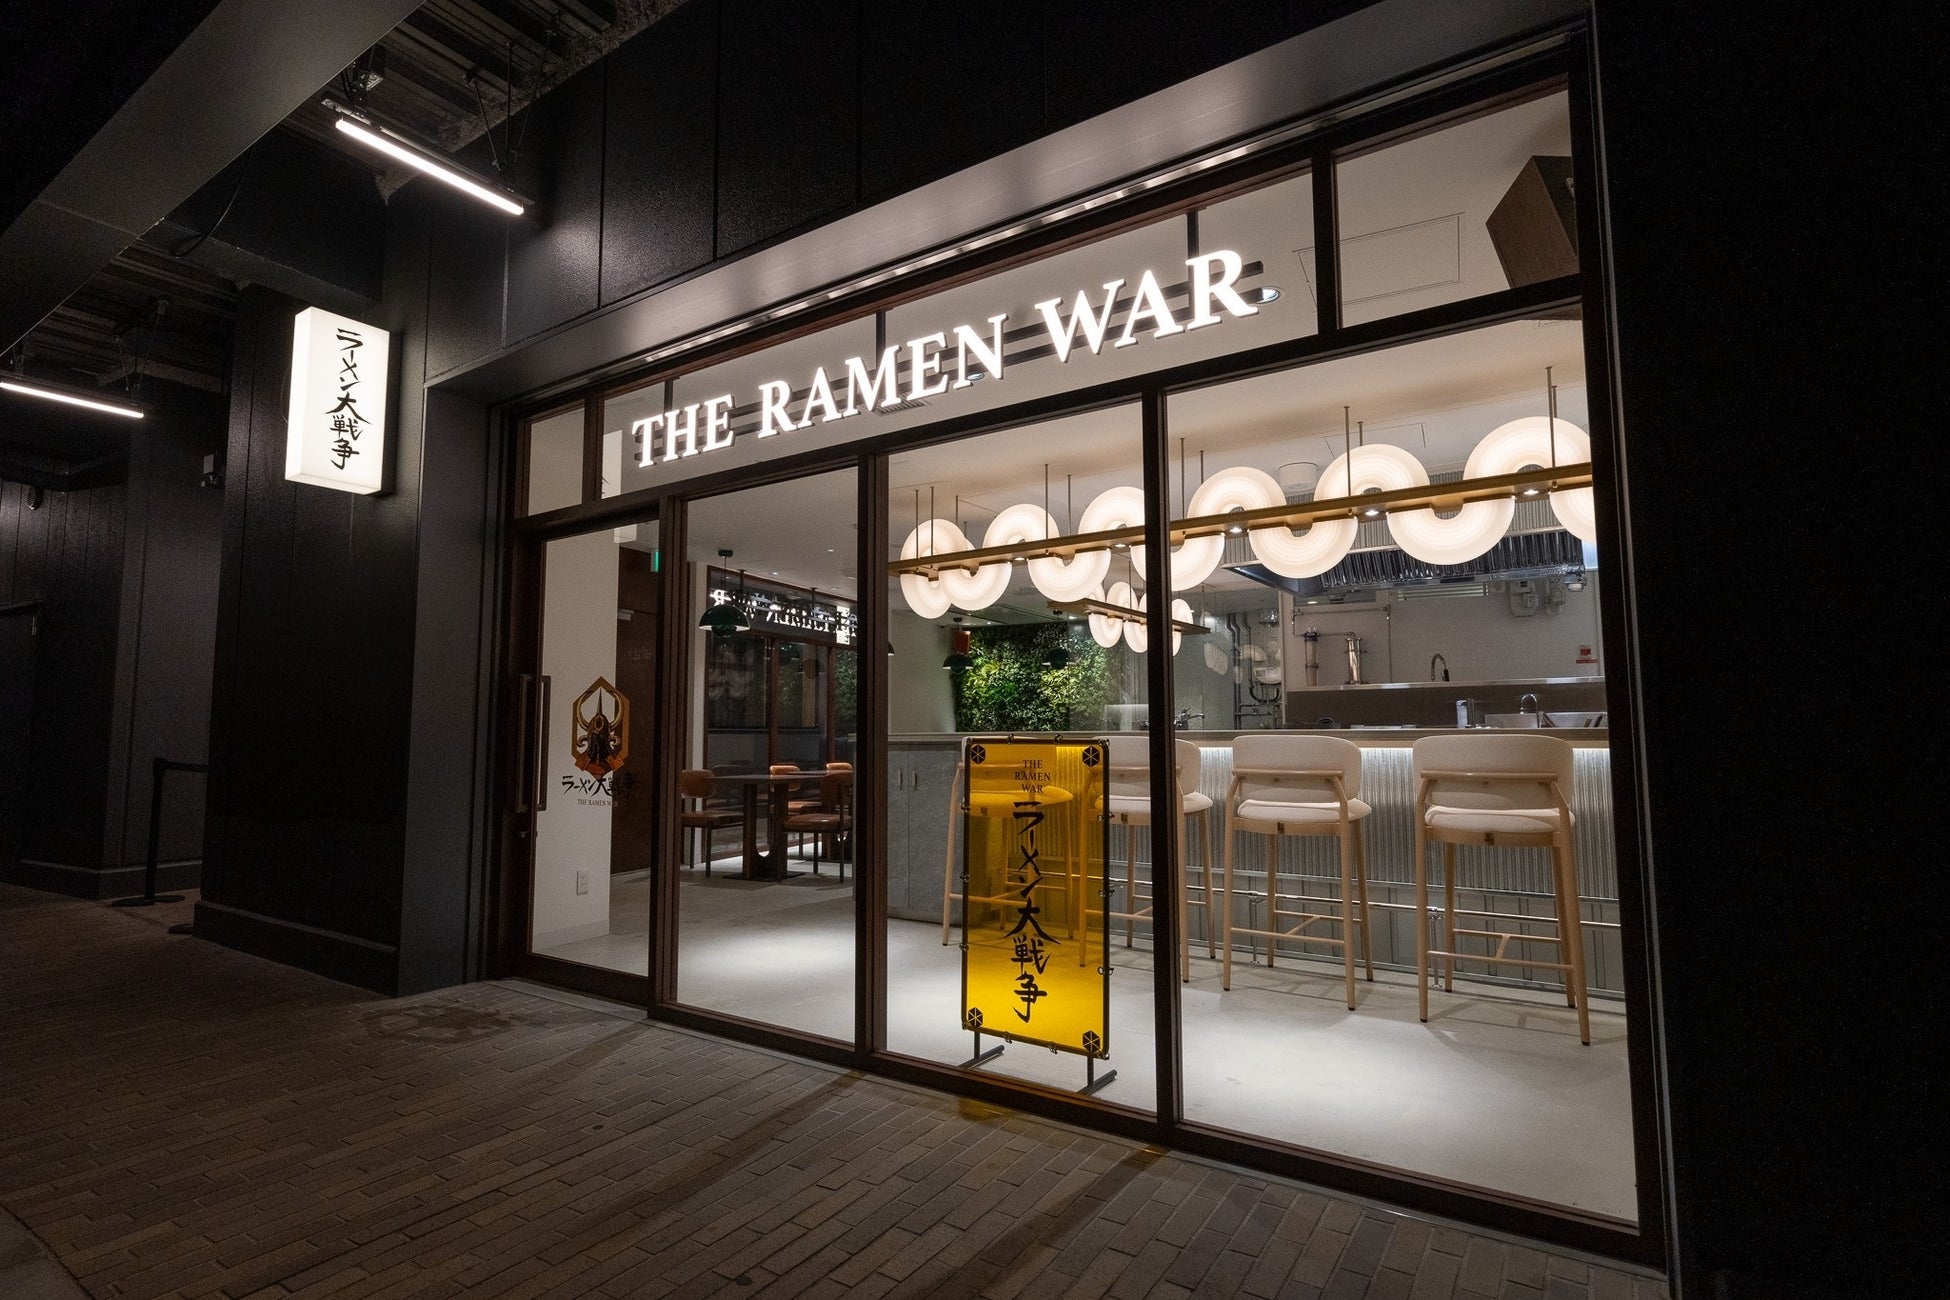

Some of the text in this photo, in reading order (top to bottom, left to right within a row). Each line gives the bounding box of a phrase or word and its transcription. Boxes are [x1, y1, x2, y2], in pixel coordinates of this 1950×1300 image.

[631, 249, 1259, 468] THE RAMEN WAR
[323, 327, 373, 471] ラーメン大戦争
[1014, 771, 1051, 781] RAMEN
[1021, 783, 1044, 793] WAR
[1022, 759, 1043, 769] THE
[1003, 801, 1062, 1024] ラーメン大戦争
